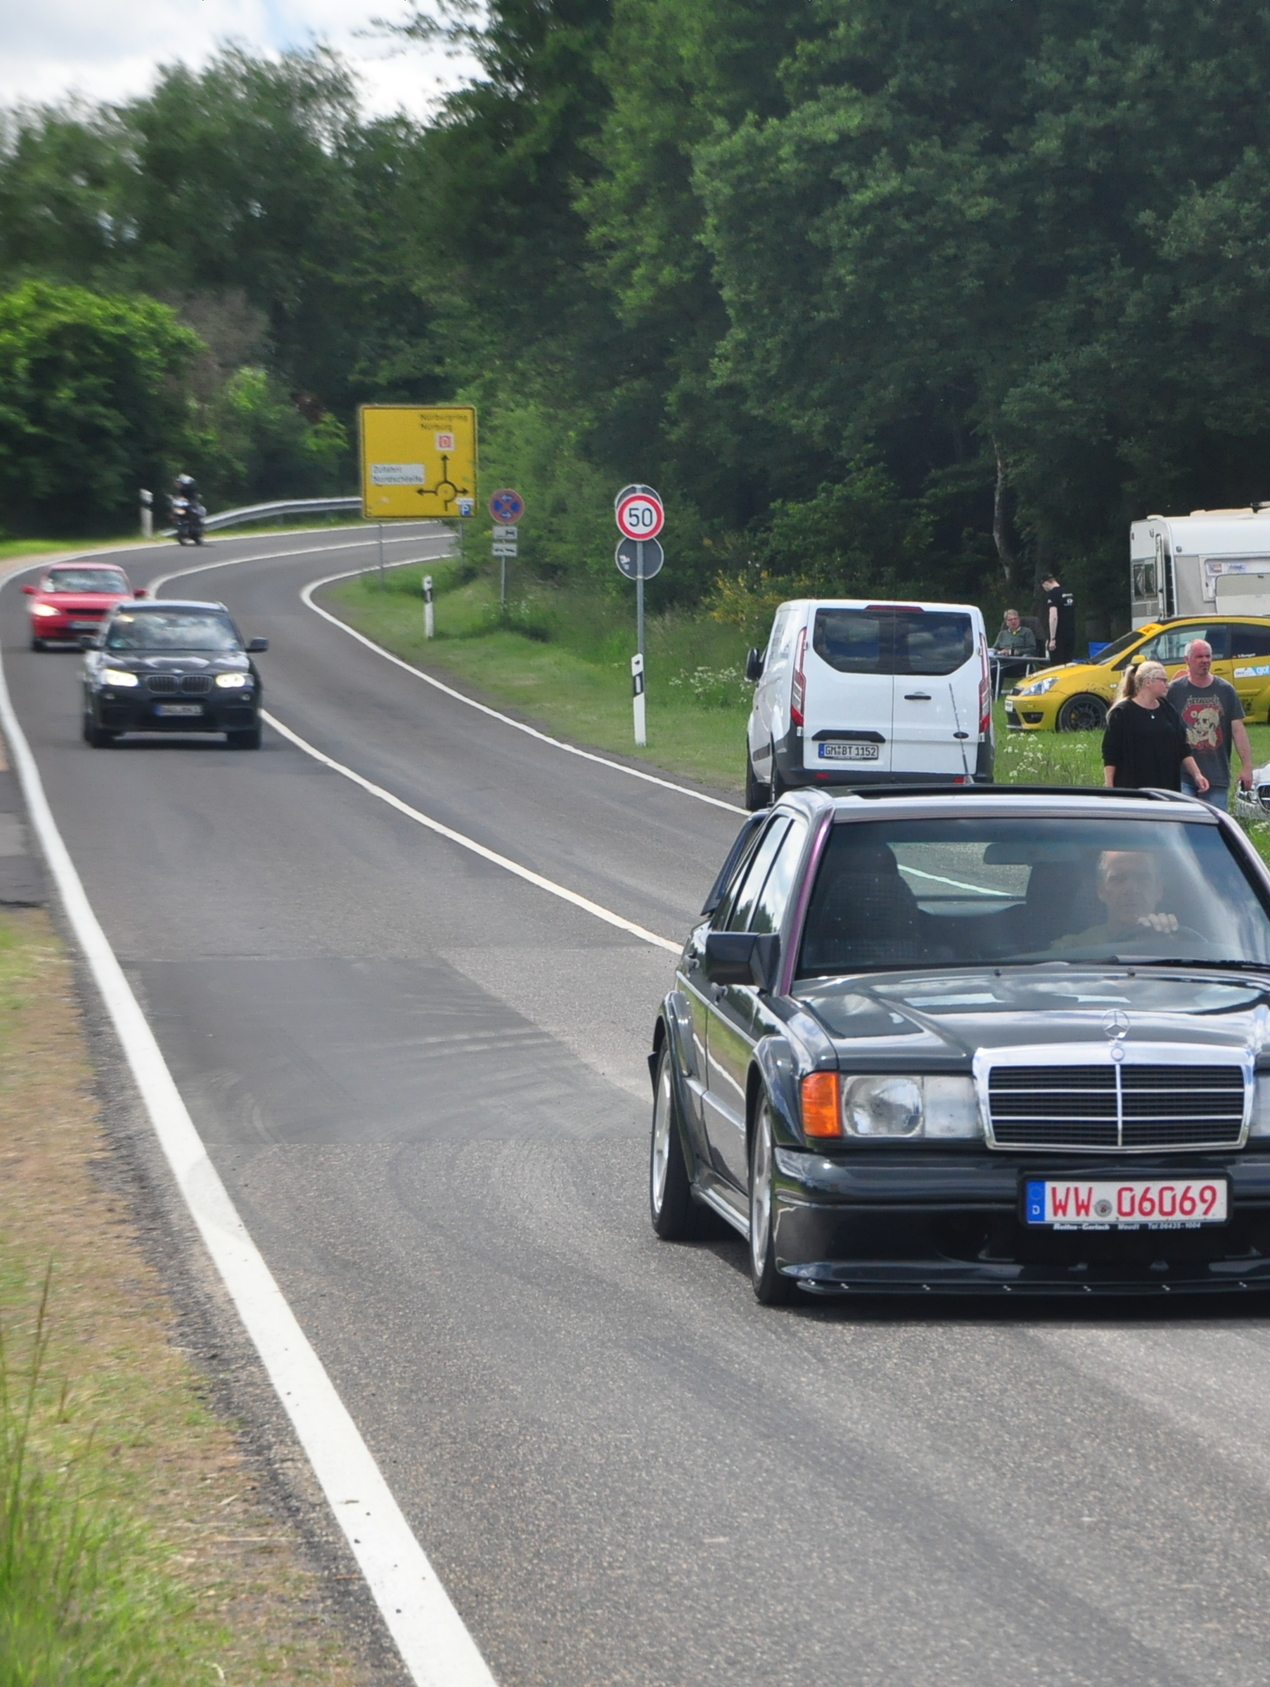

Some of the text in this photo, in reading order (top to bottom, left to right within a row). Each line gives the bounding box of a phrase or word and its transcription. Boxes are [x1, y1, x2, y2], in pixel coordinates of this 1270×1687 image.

[628, 507, 653, 527] 50
[825, 745, 876, 757] GM BT 1152
[1051, 1186, 1093, 1217] WW
[1116, 1185, 1218, 1217] 06069
